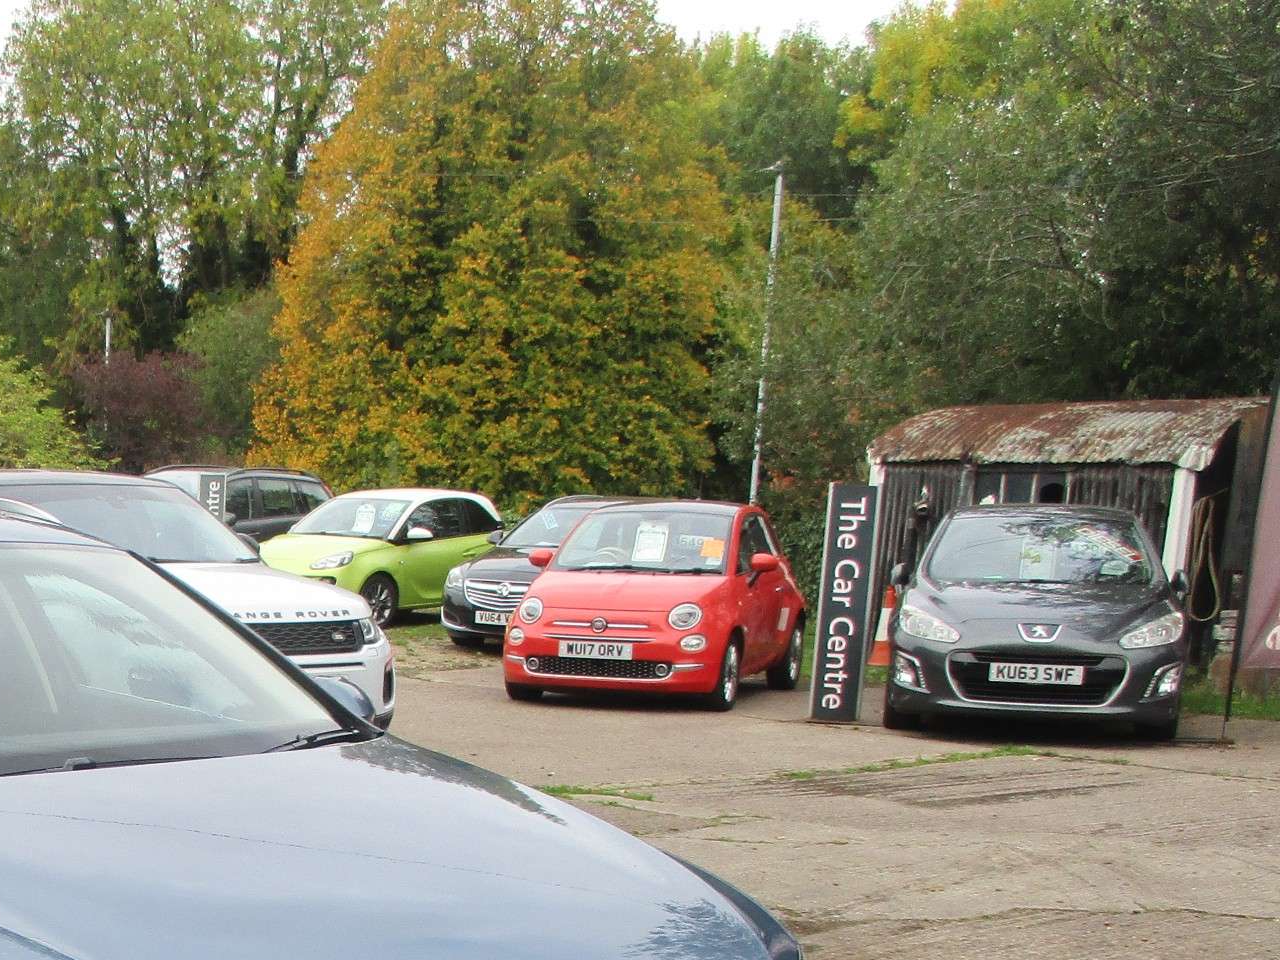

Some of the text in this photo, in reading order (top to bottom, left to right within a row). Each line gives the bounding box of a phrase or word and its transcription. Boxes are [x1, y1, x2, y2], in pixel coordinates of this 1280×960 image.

[206, 480, 221, 516] ntre
[821, 496, 867, 710] The Car Centre
[296, 609, 351, 618] ROVER
[566, 643, 624, 657] WU17 ORV
[995, 664, 1075, 682] KU63 SWF
